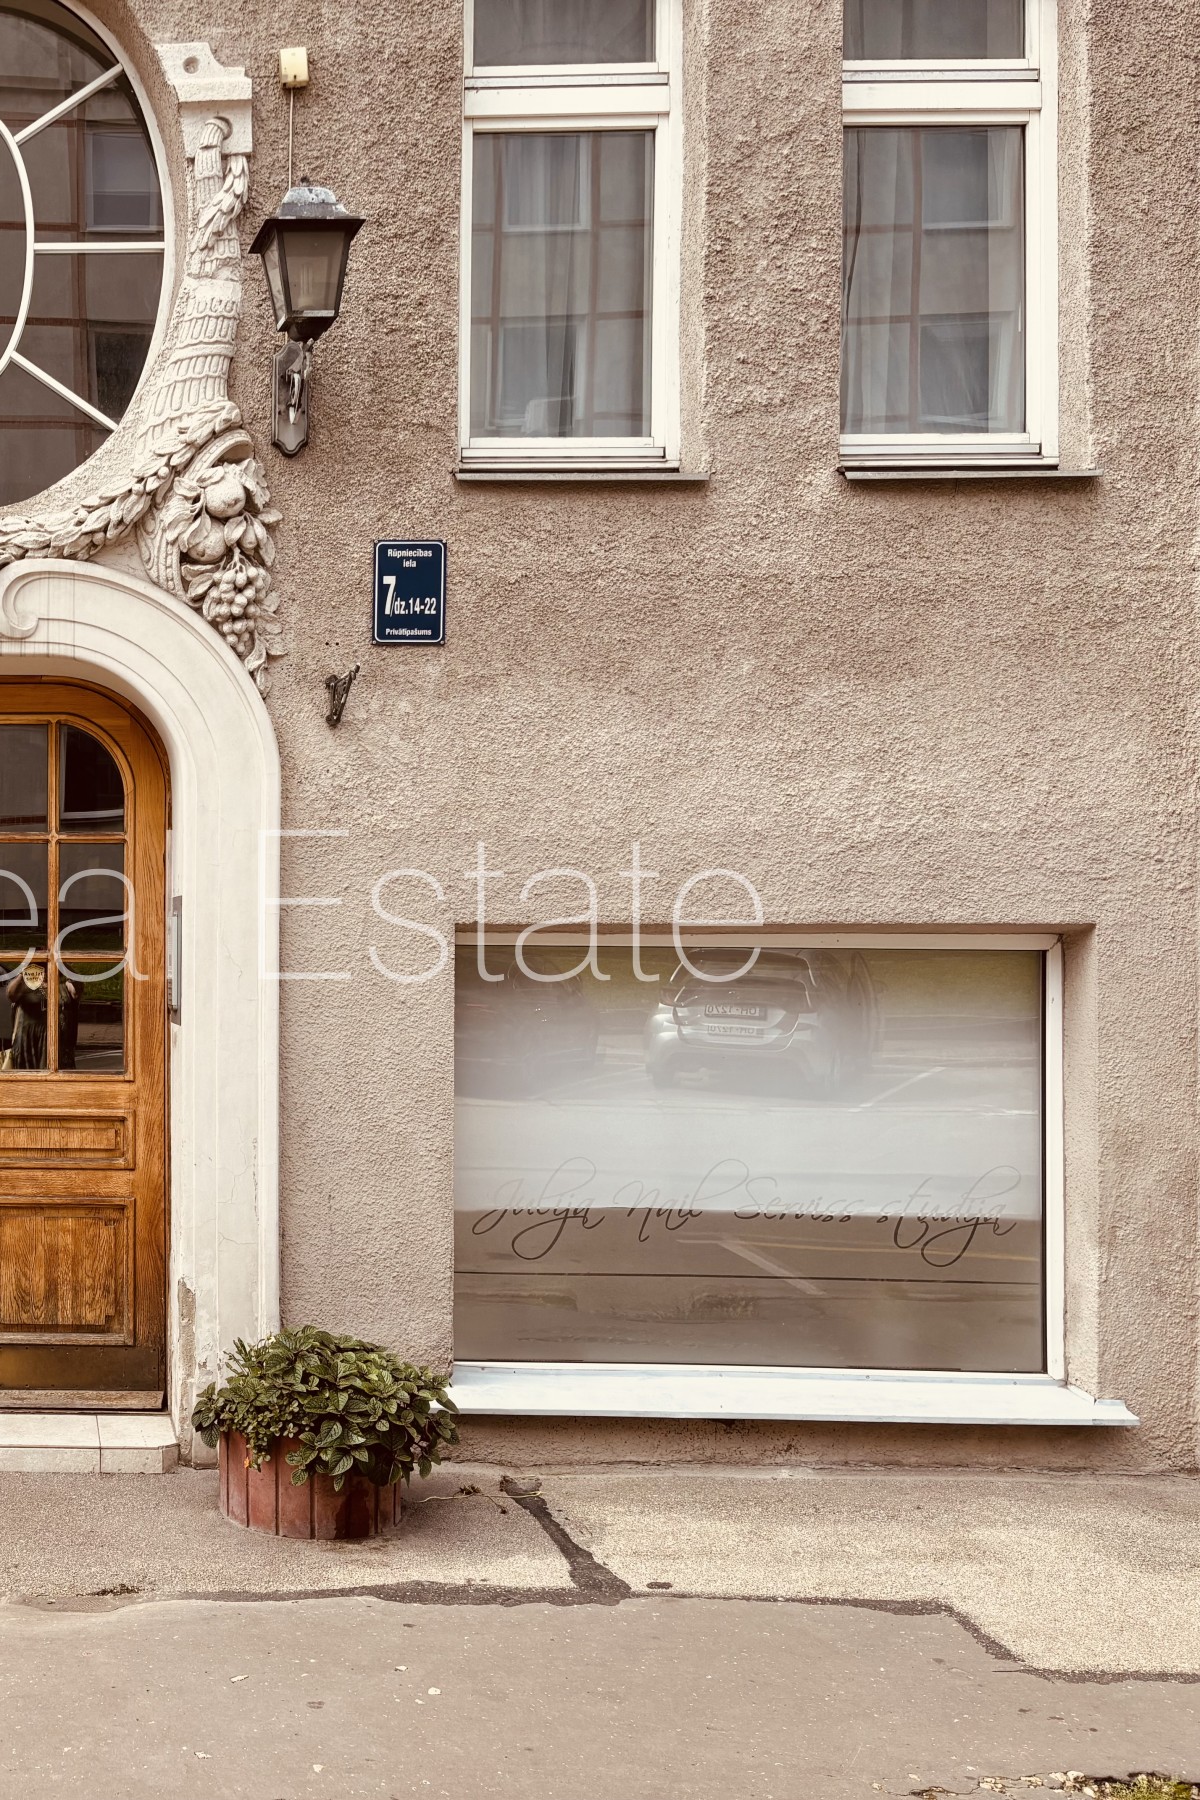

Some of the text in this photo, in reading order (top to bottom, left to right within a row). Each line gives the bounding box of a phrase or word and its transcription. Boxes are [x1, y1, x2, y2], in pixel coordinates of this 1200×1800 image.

[387, 548, 433, 558] Rūpniecības
[403, 559, 416, 568] iela
[385, 628, 432, 636] Privātīpašums
[613, 1158, 750, 1242] Nail
